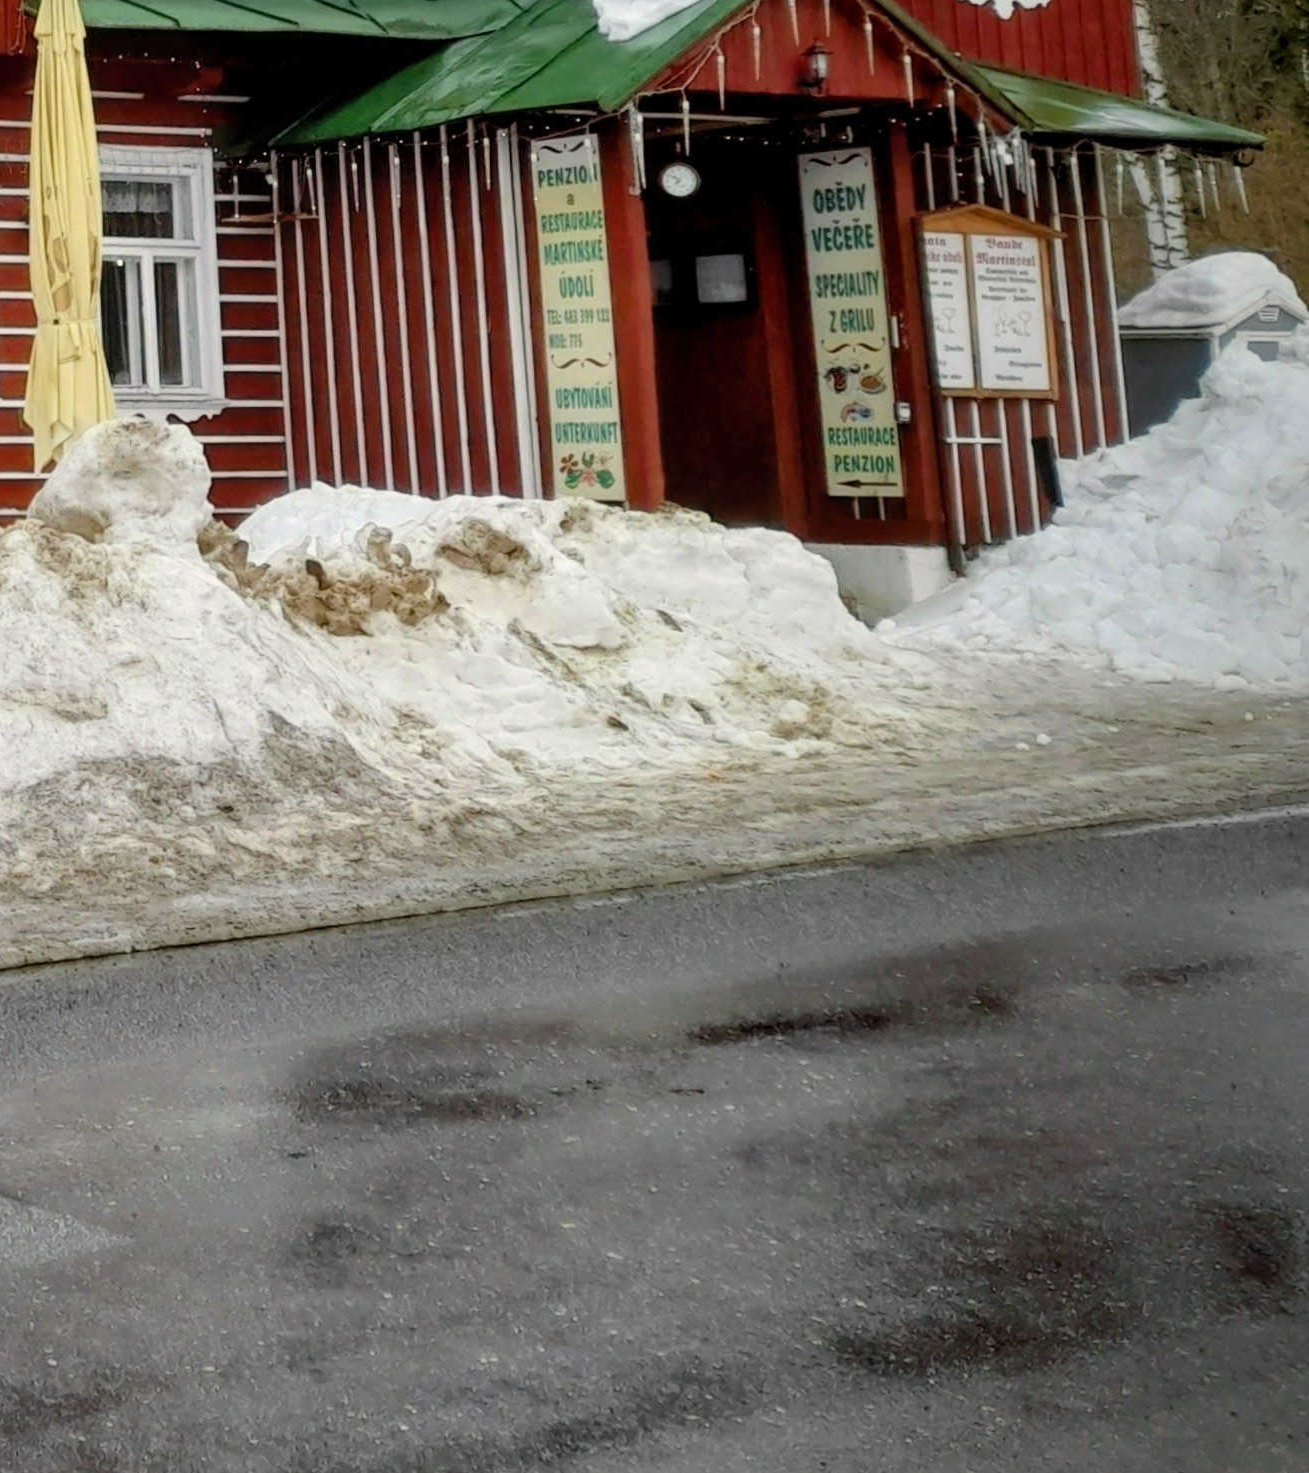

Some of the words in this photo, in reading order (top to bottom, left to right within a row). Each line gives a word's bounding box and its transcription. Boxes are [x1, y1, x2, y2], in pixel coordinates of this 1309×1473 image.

[566, 193, 575, 206] a
[812, 181, 866, 214] OBĚDY
[541, 210, 603, 234] RESTAURACE
[811, 217, 875, 253] VEČEŘE
[543, 234, 604, 266] MARTINSKÉ
[559, 268, 595, 299] ÚDOLÍ
[814, 268, 880, 299] SPECIALITY
[829, 309, 837, 334] Z
[840, 308, 875, 333] GRILU
[555, 381, 613, 410] UBYTOVÁNÍ
[554, 421, 618, 445] UNTERKUNFT
[827, 426, 896, 447] RESTAURACE
[833, 454, 896, 474] PENZION
